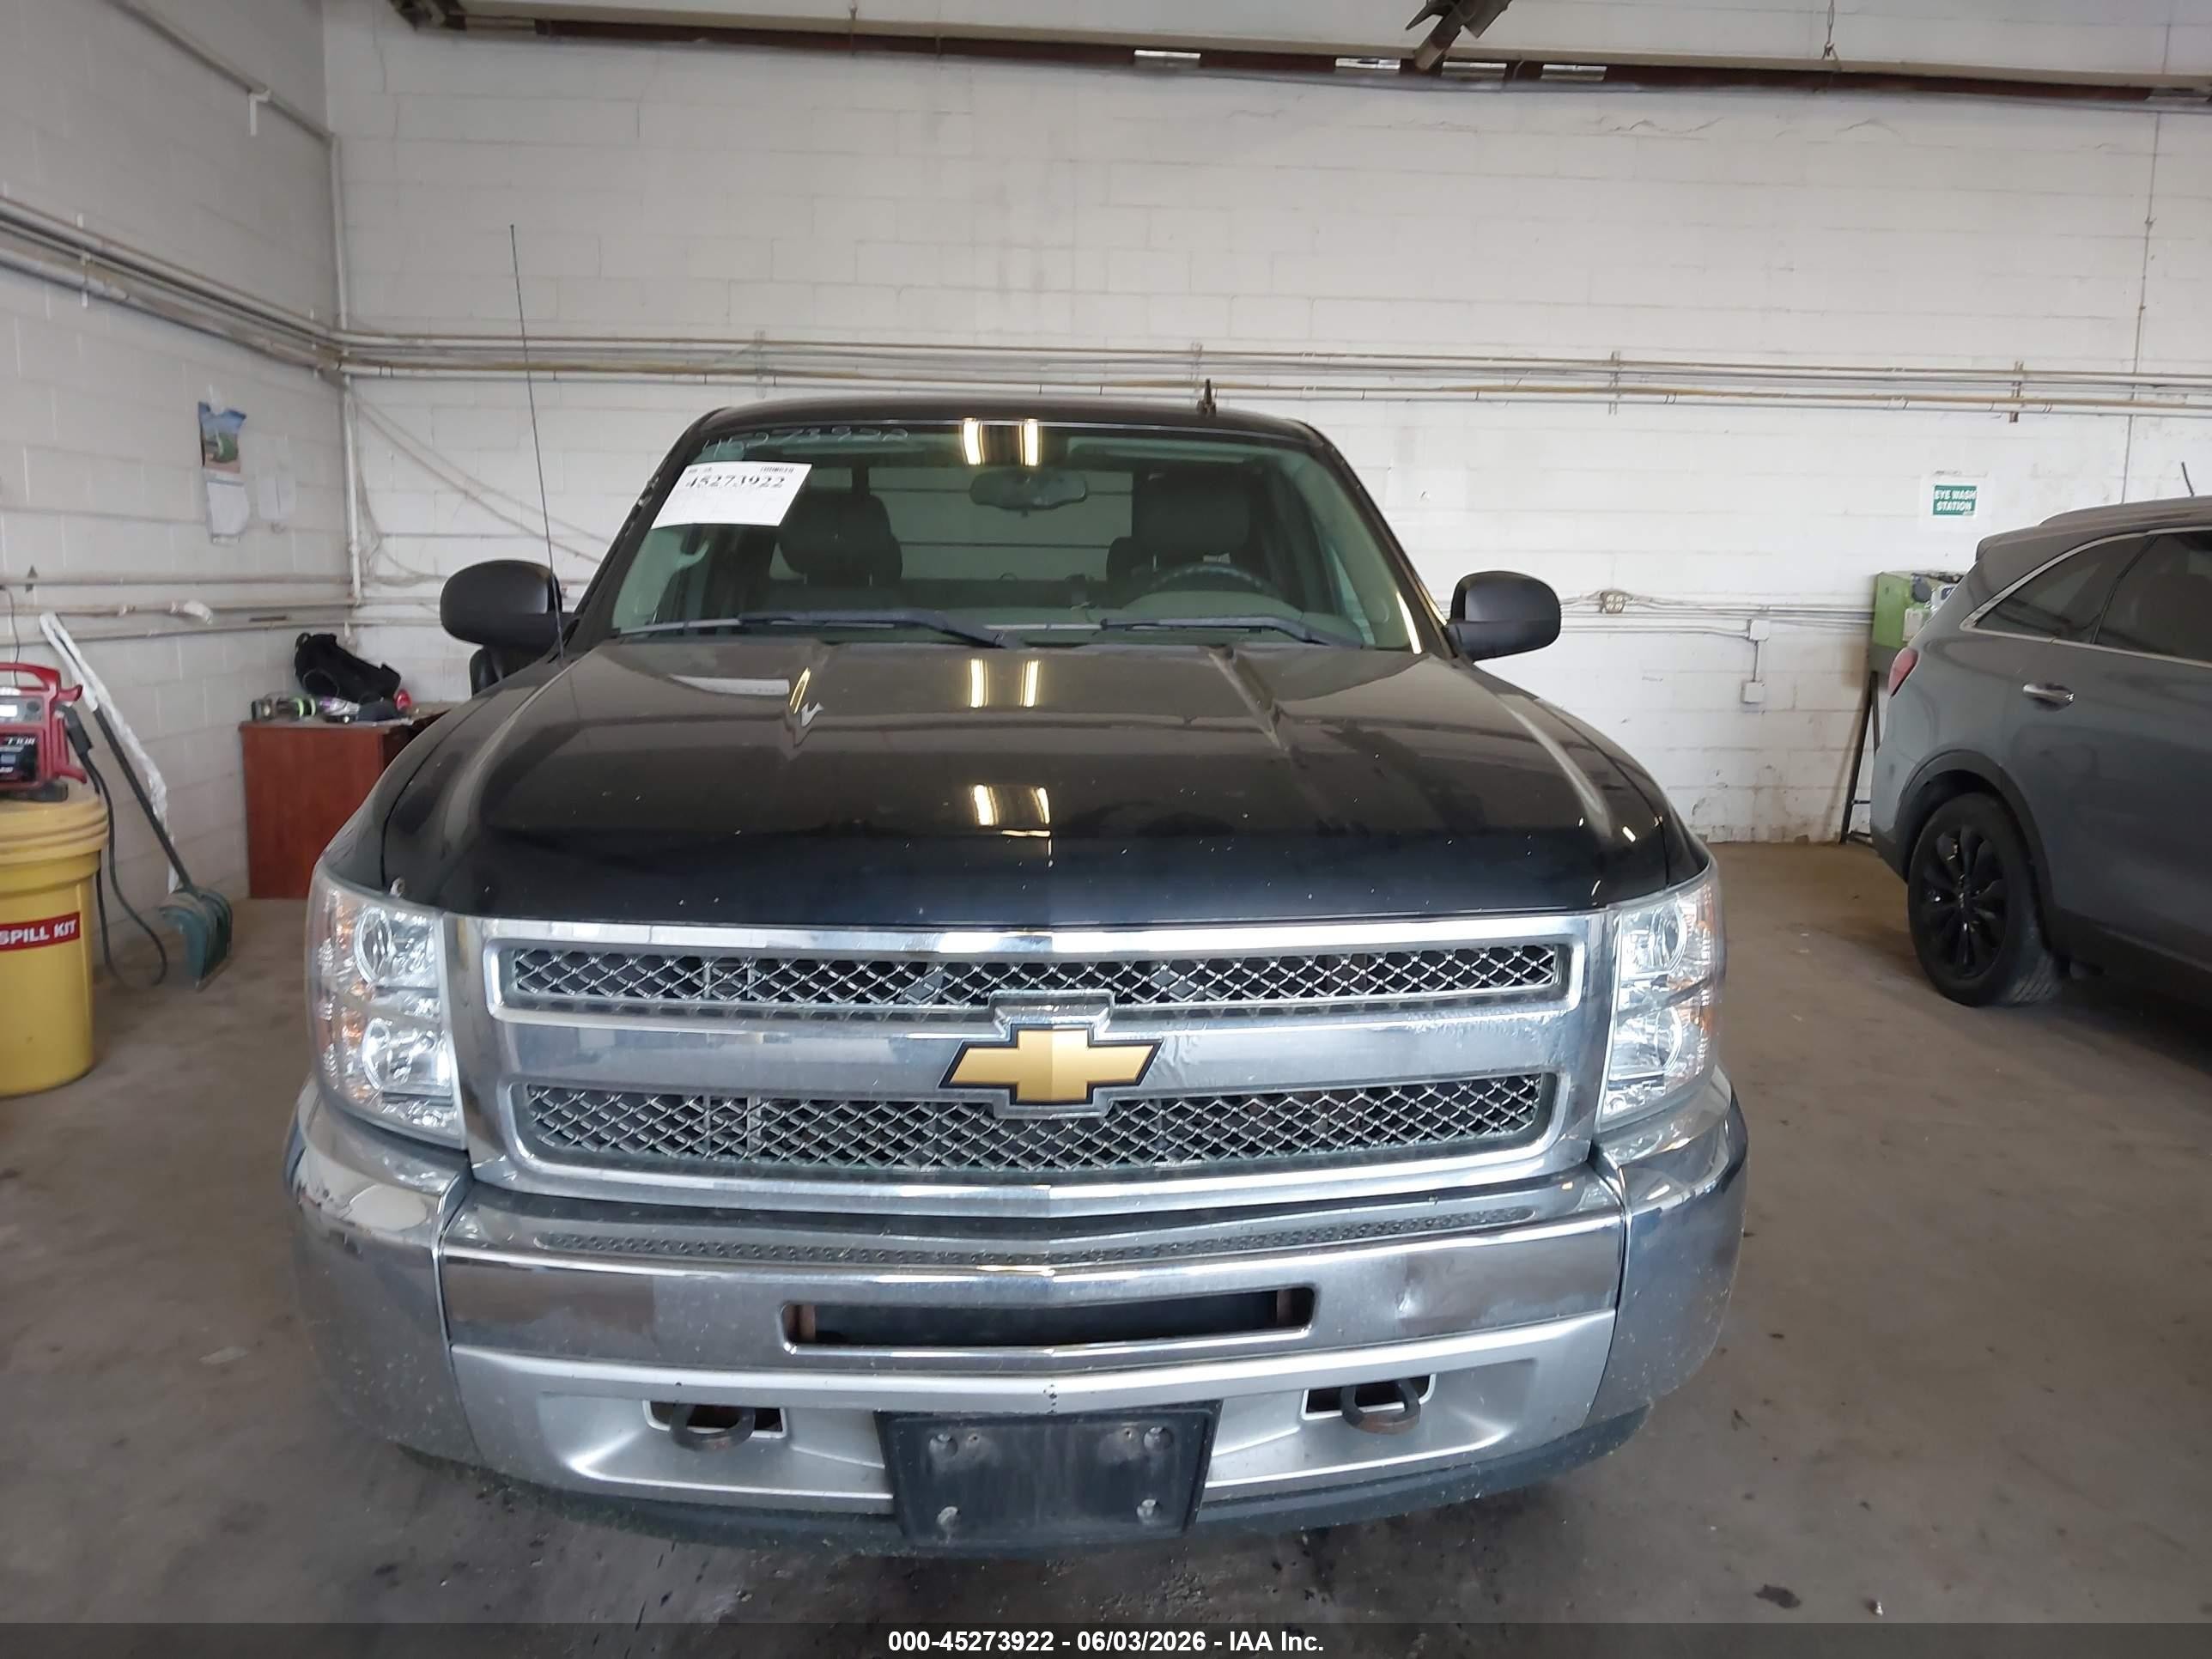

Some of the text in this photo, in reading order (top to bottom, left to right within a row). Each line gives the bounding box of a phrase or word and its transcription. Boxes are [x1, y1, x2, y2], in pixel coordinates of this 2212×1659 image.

[685, 474, 787, 489] 45273922
[1935, 489, 1977, 500] EYE WASH
[1936, 501, 1972, 512] STATION
[0, 919, 77, 945] SPILL KIT
